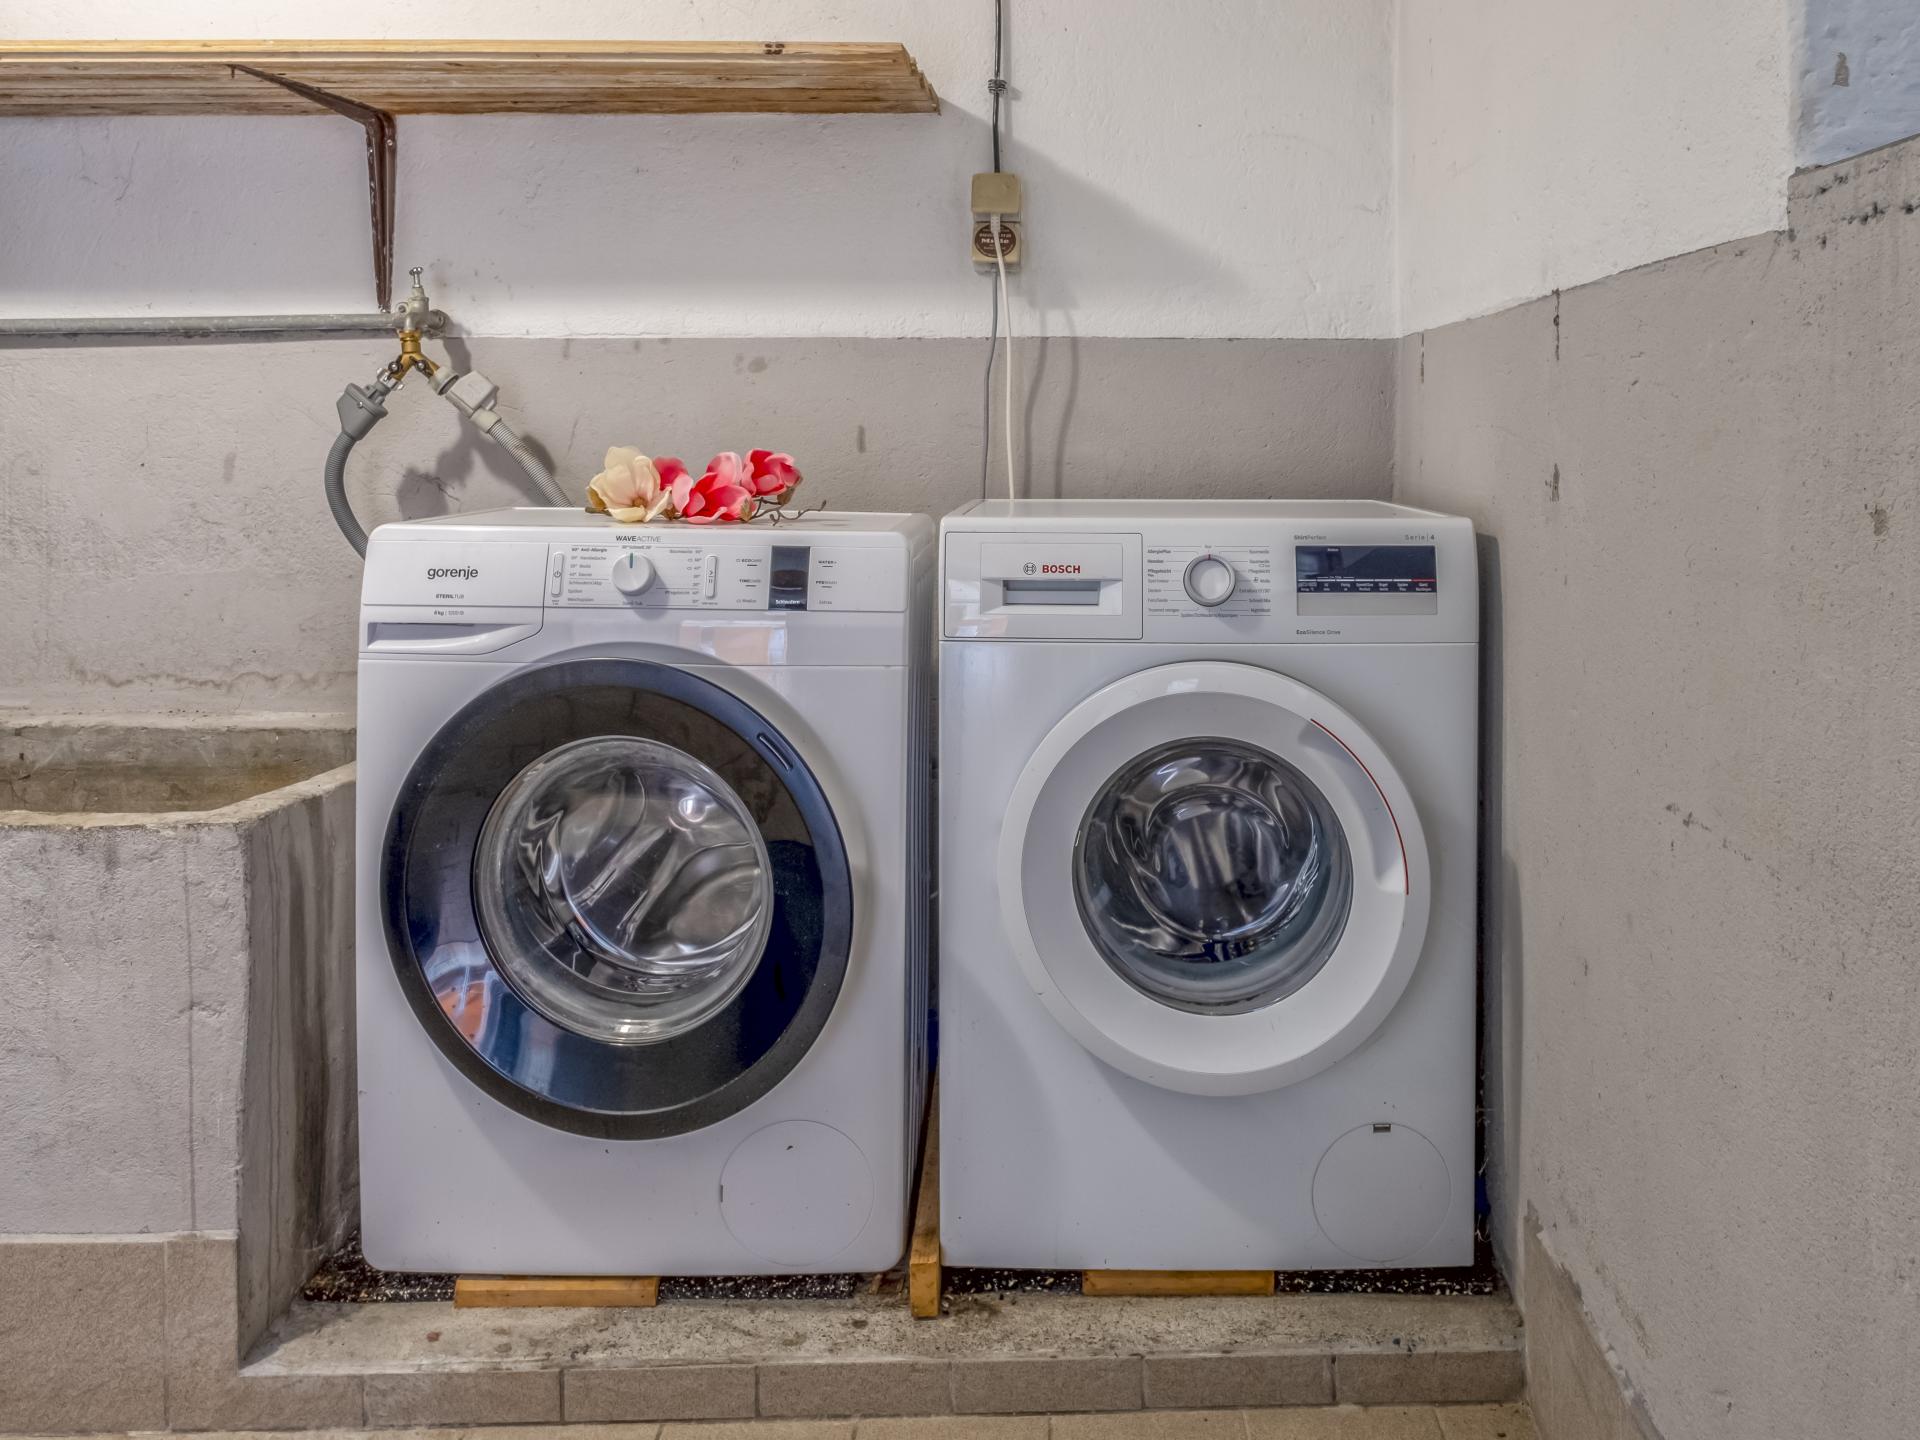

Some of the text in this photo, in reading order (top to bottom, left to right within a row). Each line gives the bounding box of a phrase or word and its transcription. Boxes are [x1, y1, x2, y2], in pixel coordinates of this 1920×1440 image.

[616, 535, 662, 543] WAVEACTIVE
[427, 565, 479, 580] gorenje
[1042, 564, 1081, 574] BOSCH
